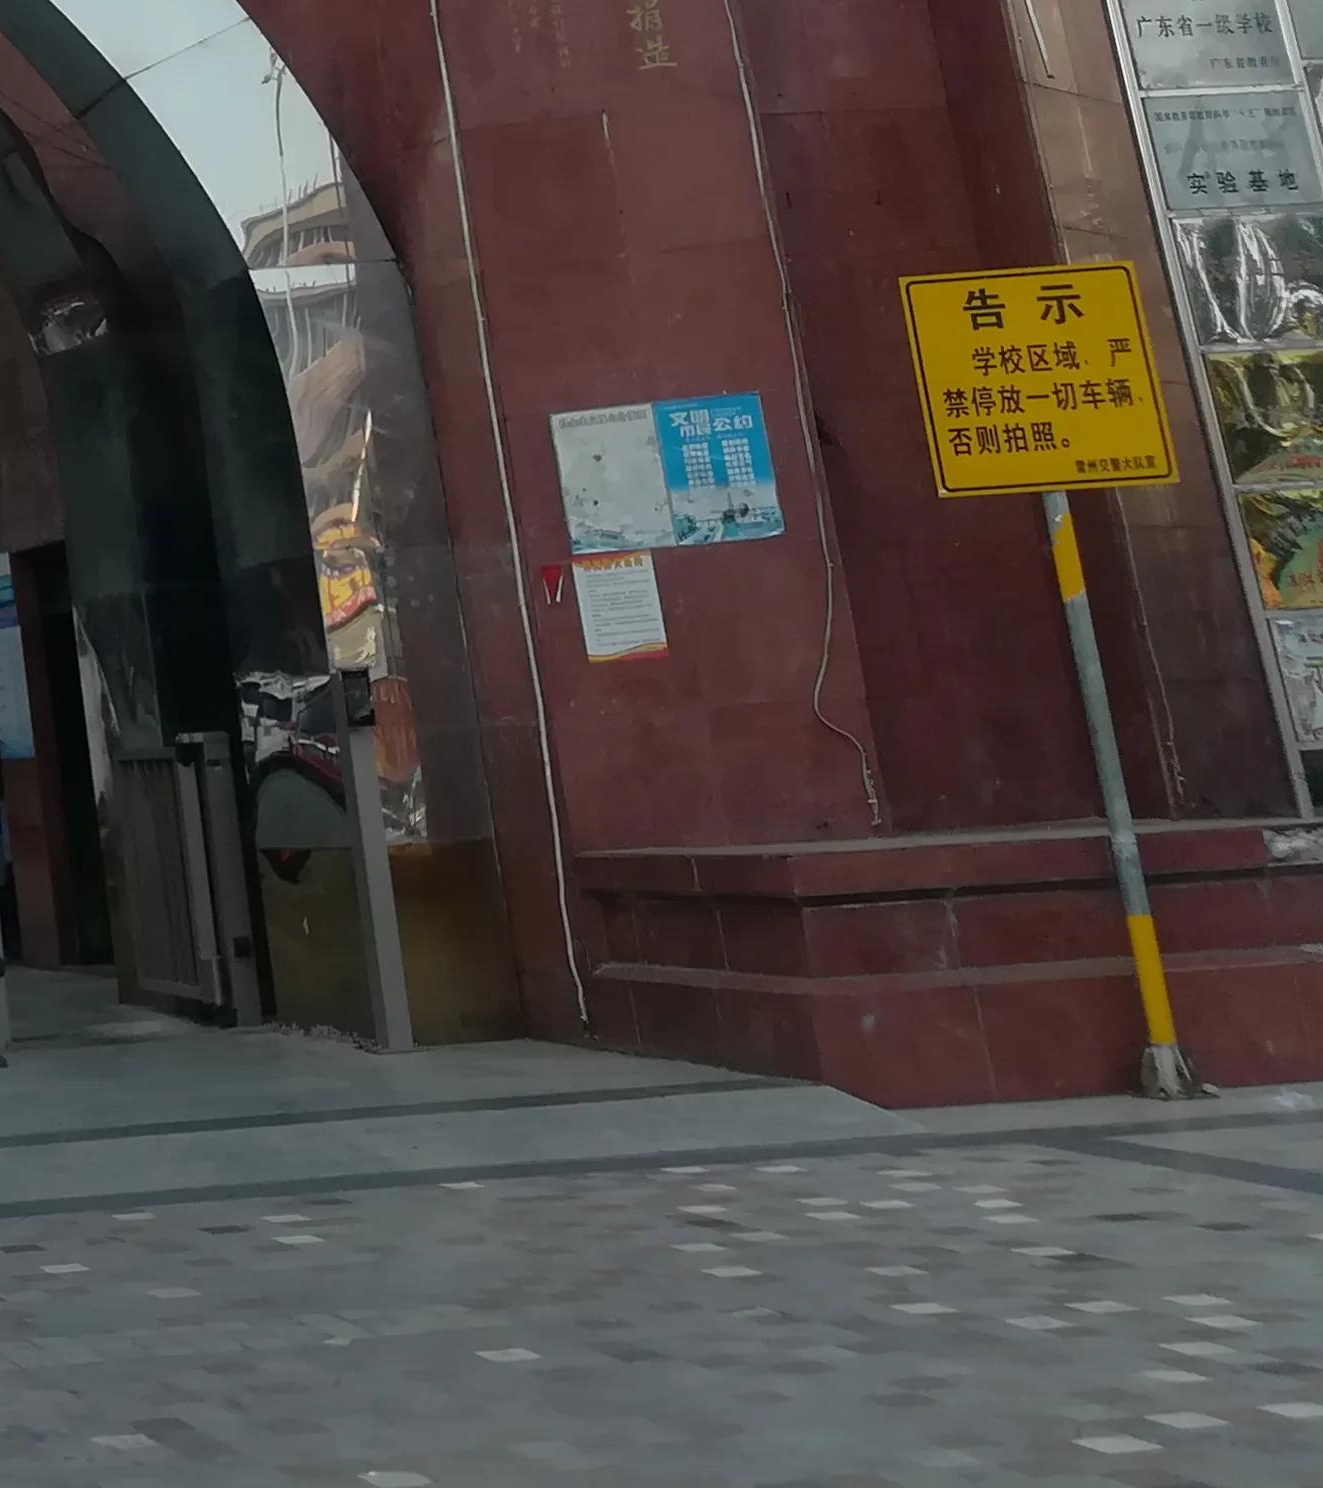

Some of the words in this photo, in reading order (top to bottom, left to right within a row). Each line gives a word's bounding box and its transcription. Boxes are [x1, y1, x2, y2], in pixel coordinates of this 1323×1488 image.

[1136, 13, 1273, 39] 广东省一级学校
[1186, 169, 1300, 195] 实验基地
[963, 284, 1084, 331] 告示
